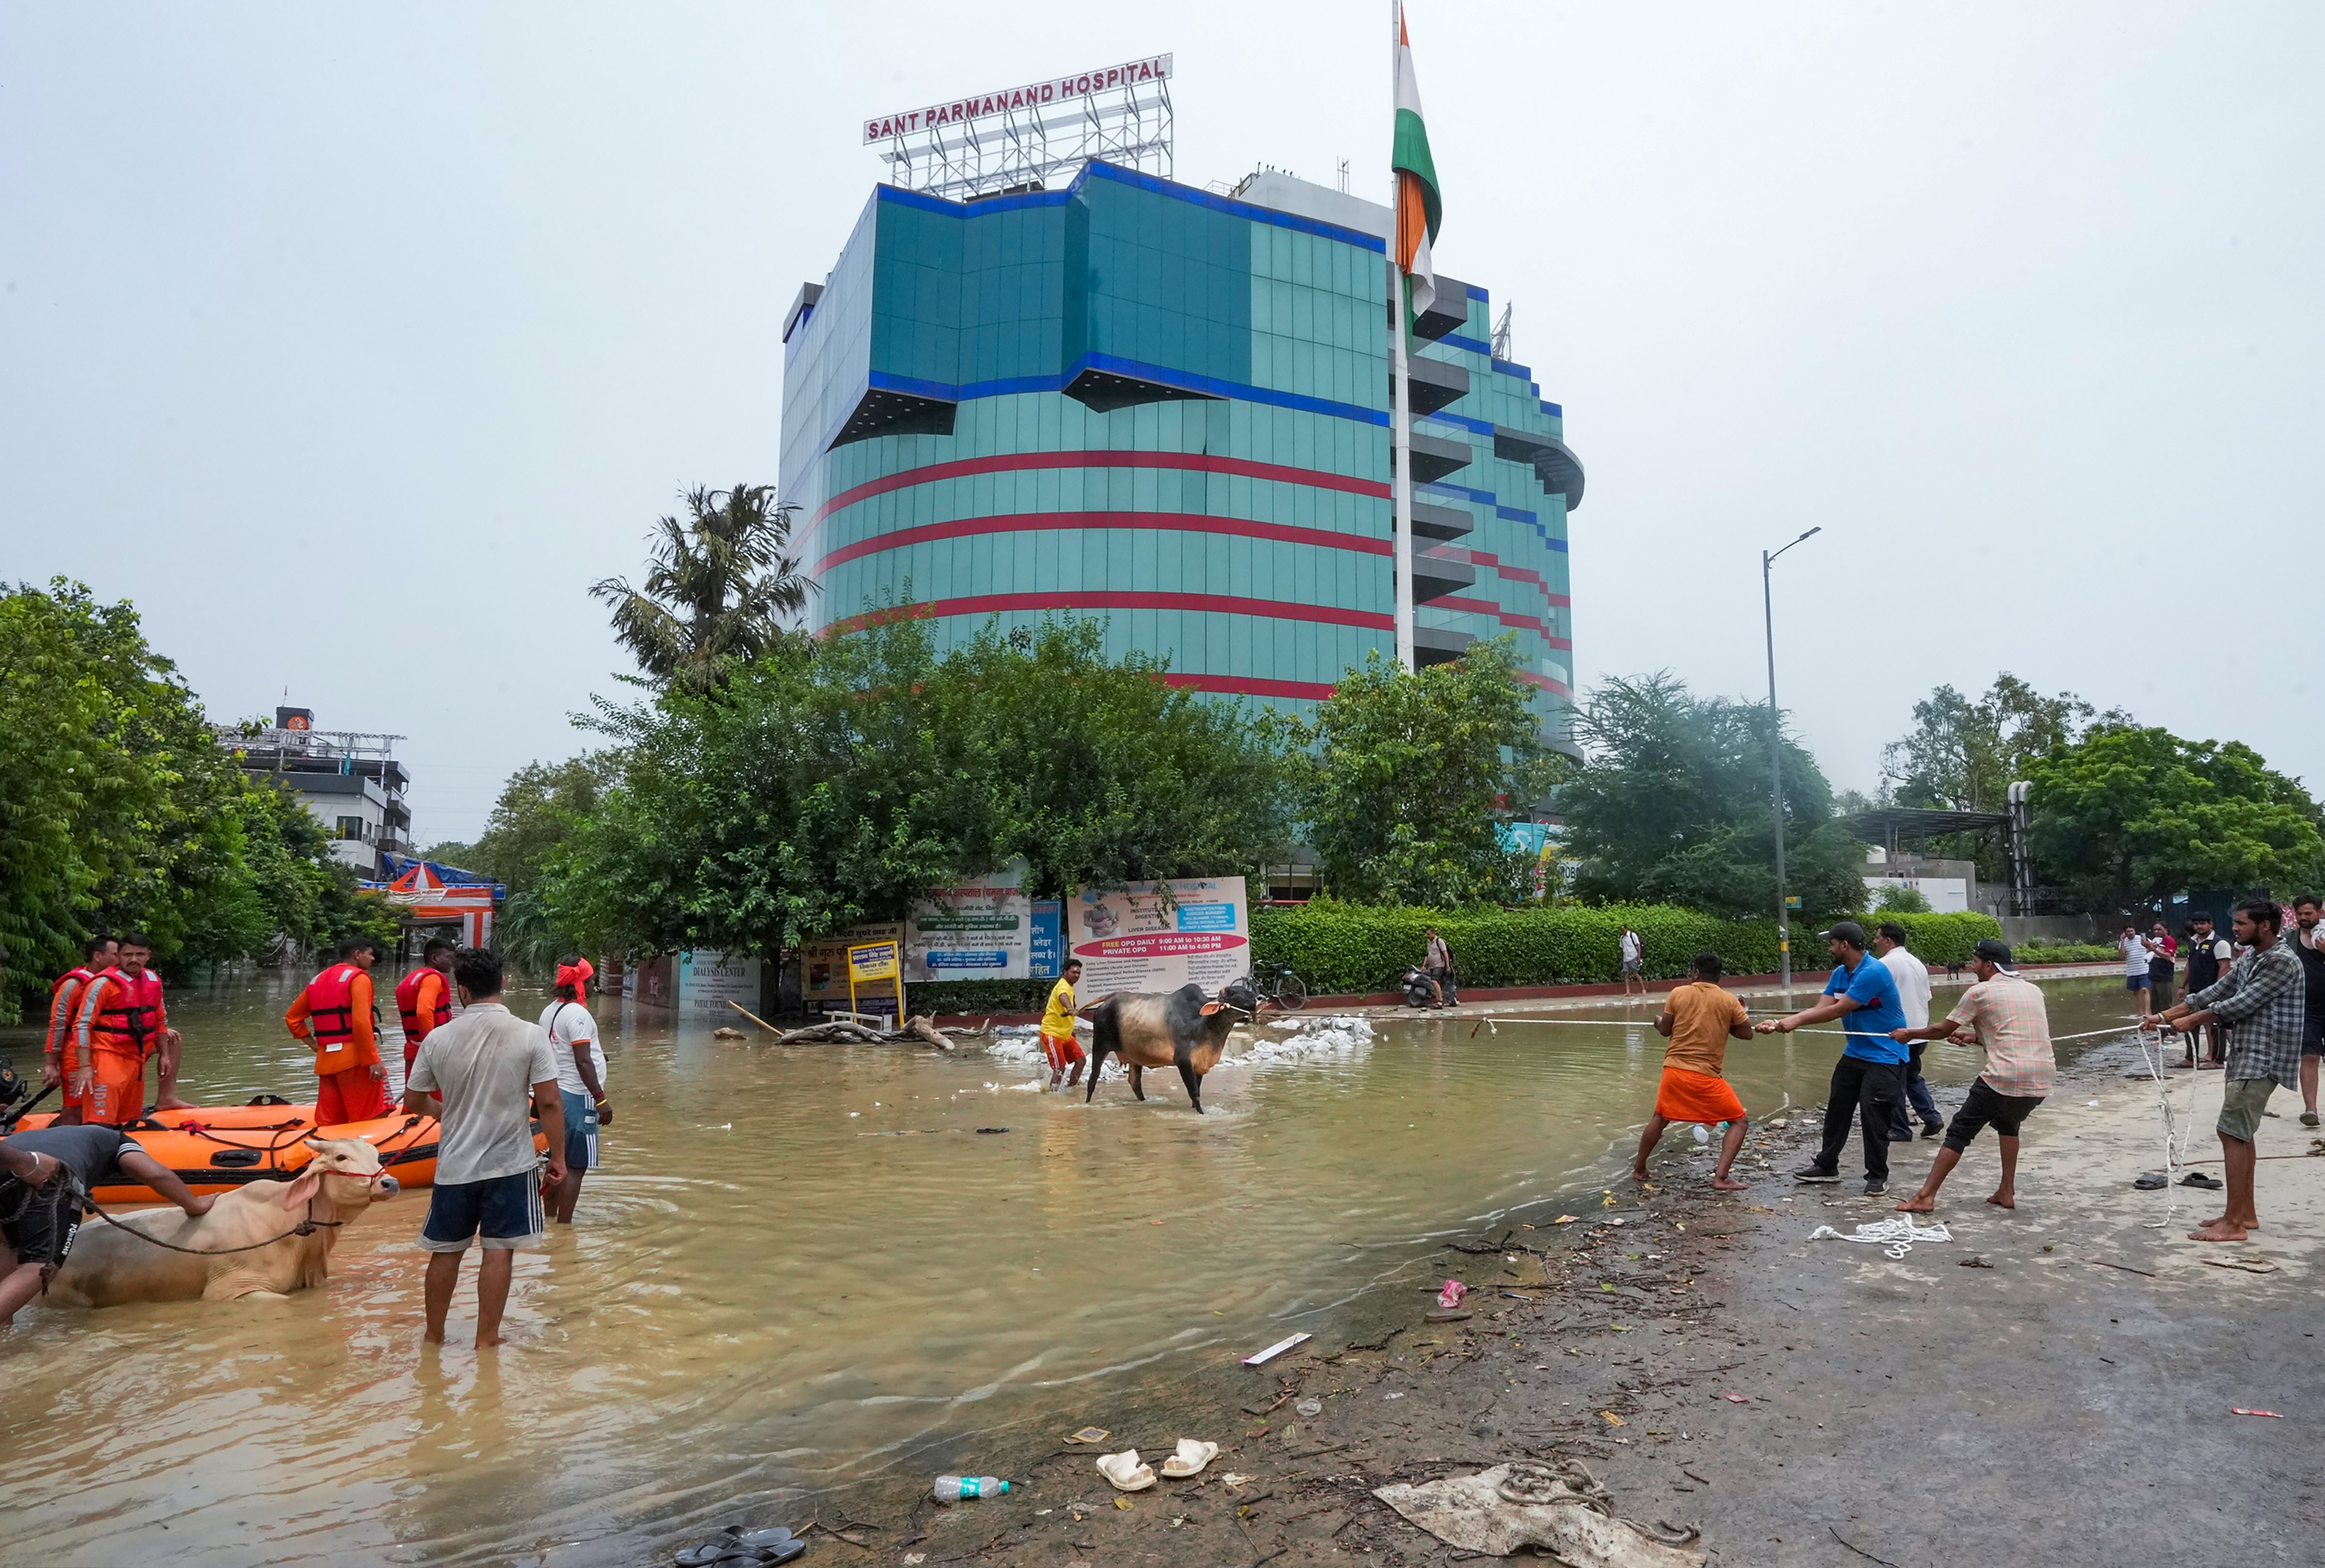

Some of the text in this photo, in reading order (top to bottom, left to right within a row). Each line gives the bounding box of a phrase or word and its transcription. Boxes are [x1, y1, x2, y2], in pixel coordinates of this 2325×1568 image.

[868, 60, 1165, 140] SANT PARMANAND HOSPITAL
[1031, 925, 1044, 934] शीन
[693, 966, 745, 977] DIALYSIS CENTER
[94, 1084, 108, 1115] NDRF
